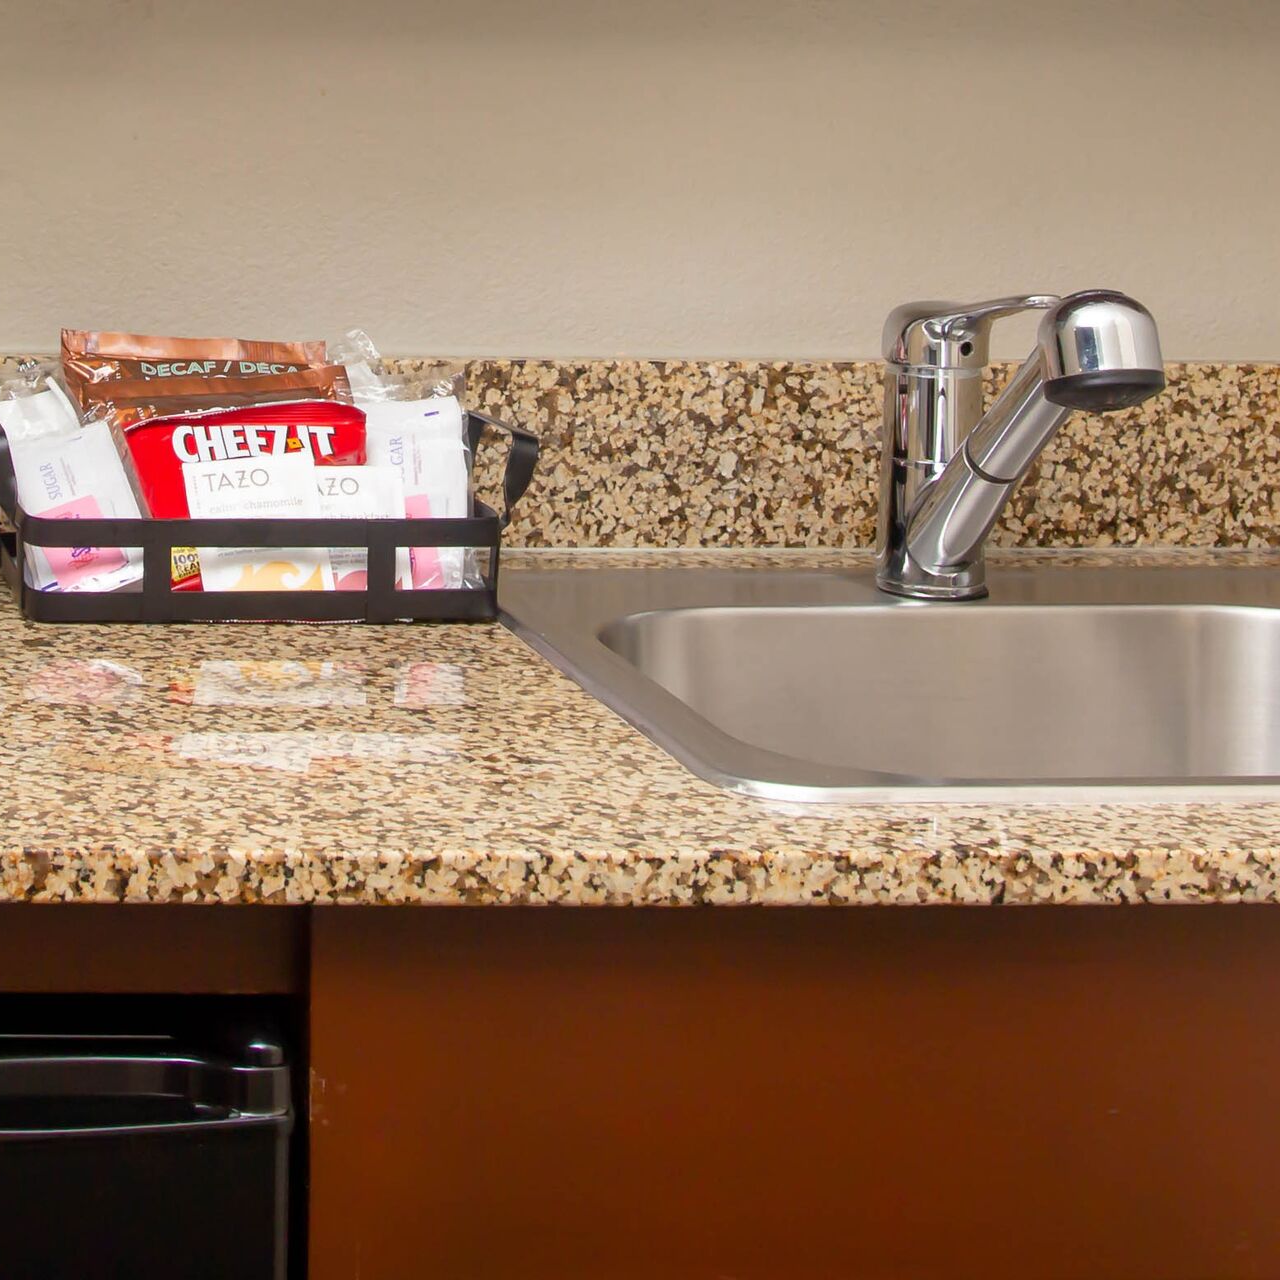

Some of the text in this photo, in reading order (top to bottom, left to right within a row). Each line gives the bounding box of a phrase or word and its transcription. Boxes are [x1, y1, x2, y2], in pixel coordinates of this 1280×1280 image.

[140, 360, 217, 377] DECAF
[38, 462, 63, 501] SUGAR
[202, 468, 269, 493] TAZO
[317, 477, 359, 496] ZO
[243, 496, 303, 510] chamomile
